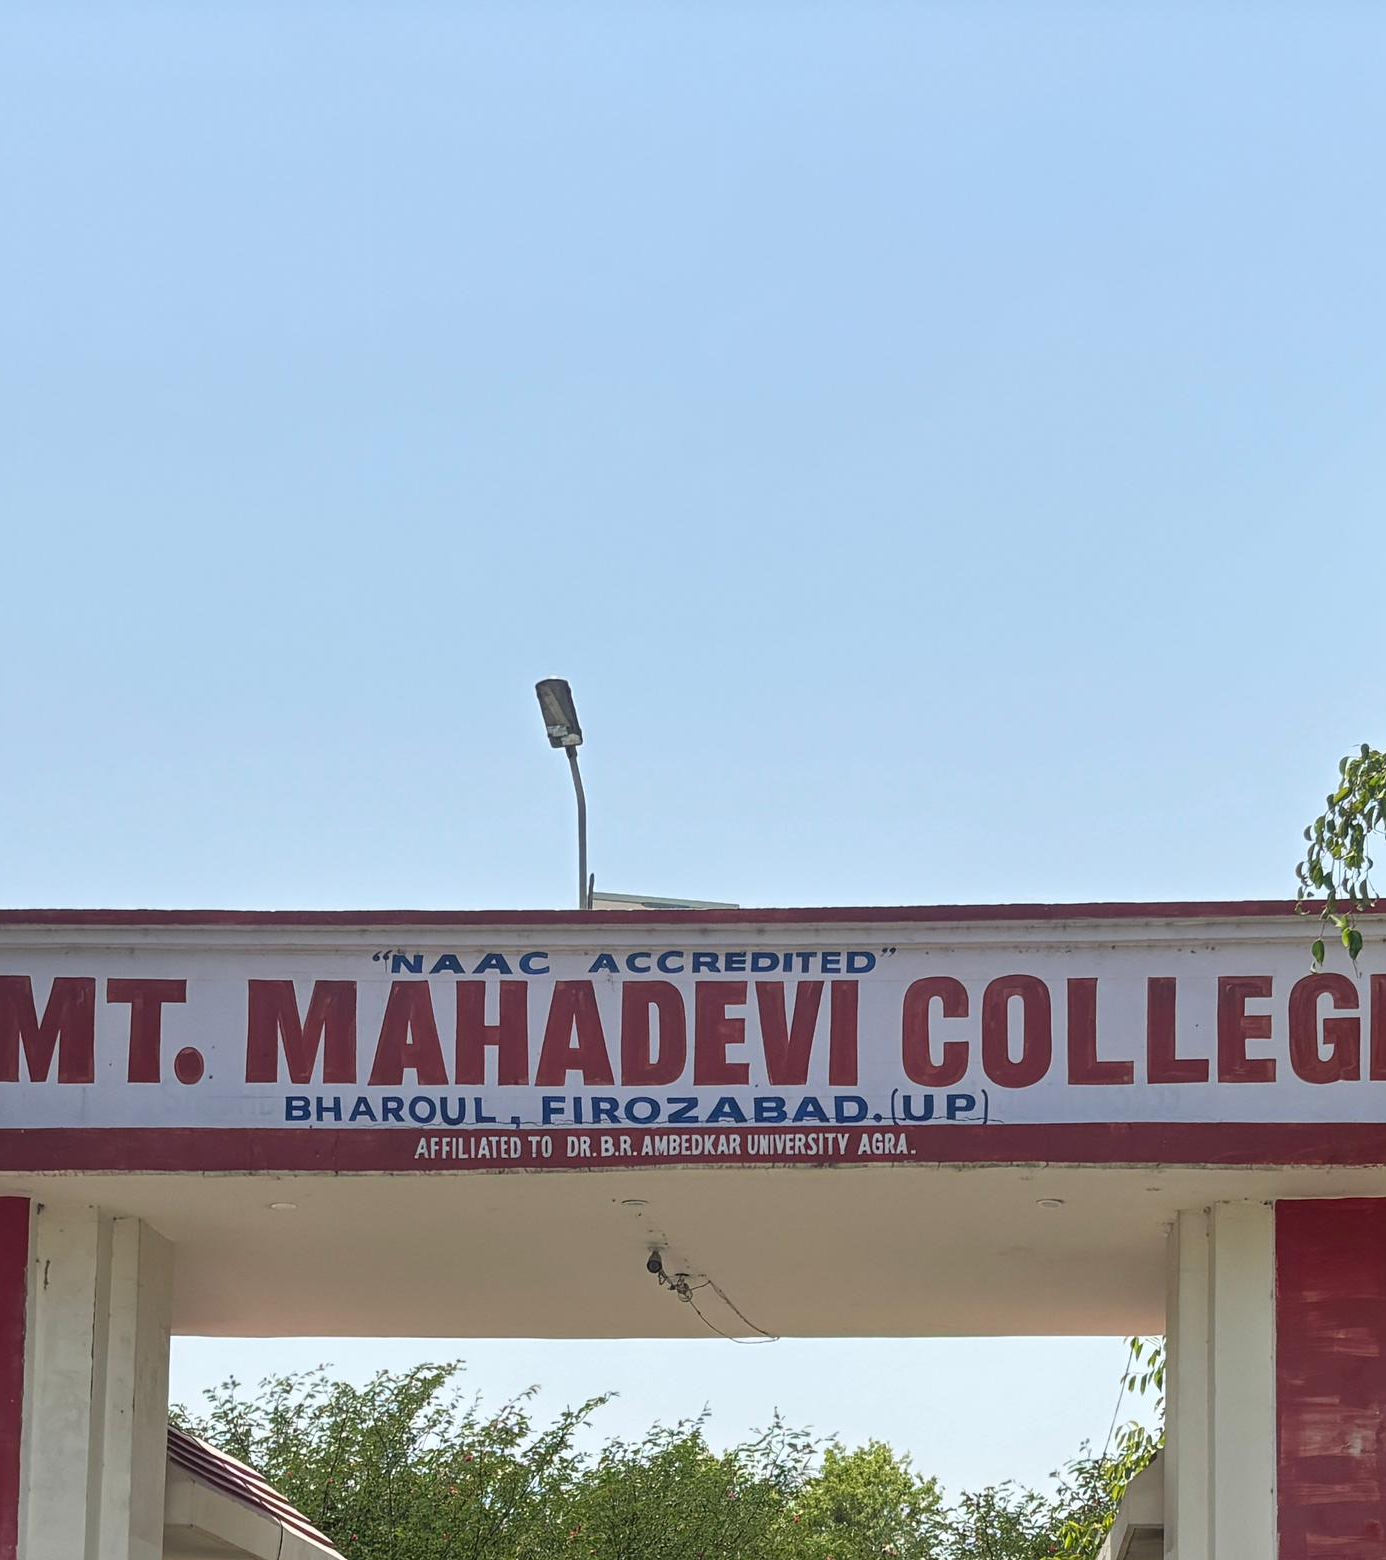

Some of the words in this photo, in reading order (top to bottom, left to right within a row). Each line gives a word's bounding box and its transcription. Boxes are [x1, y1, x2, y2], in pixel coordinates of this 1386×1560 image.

[245, 979, 859, 1087] MAHADEVI
[414, 1136, 521, 1159] AFFILIATED
[528, 1136, 552, 1158] TO
[747, 1133, 850, 1156] UNIVERSITY
[857, 1132, 917, 1156] AGRA.
